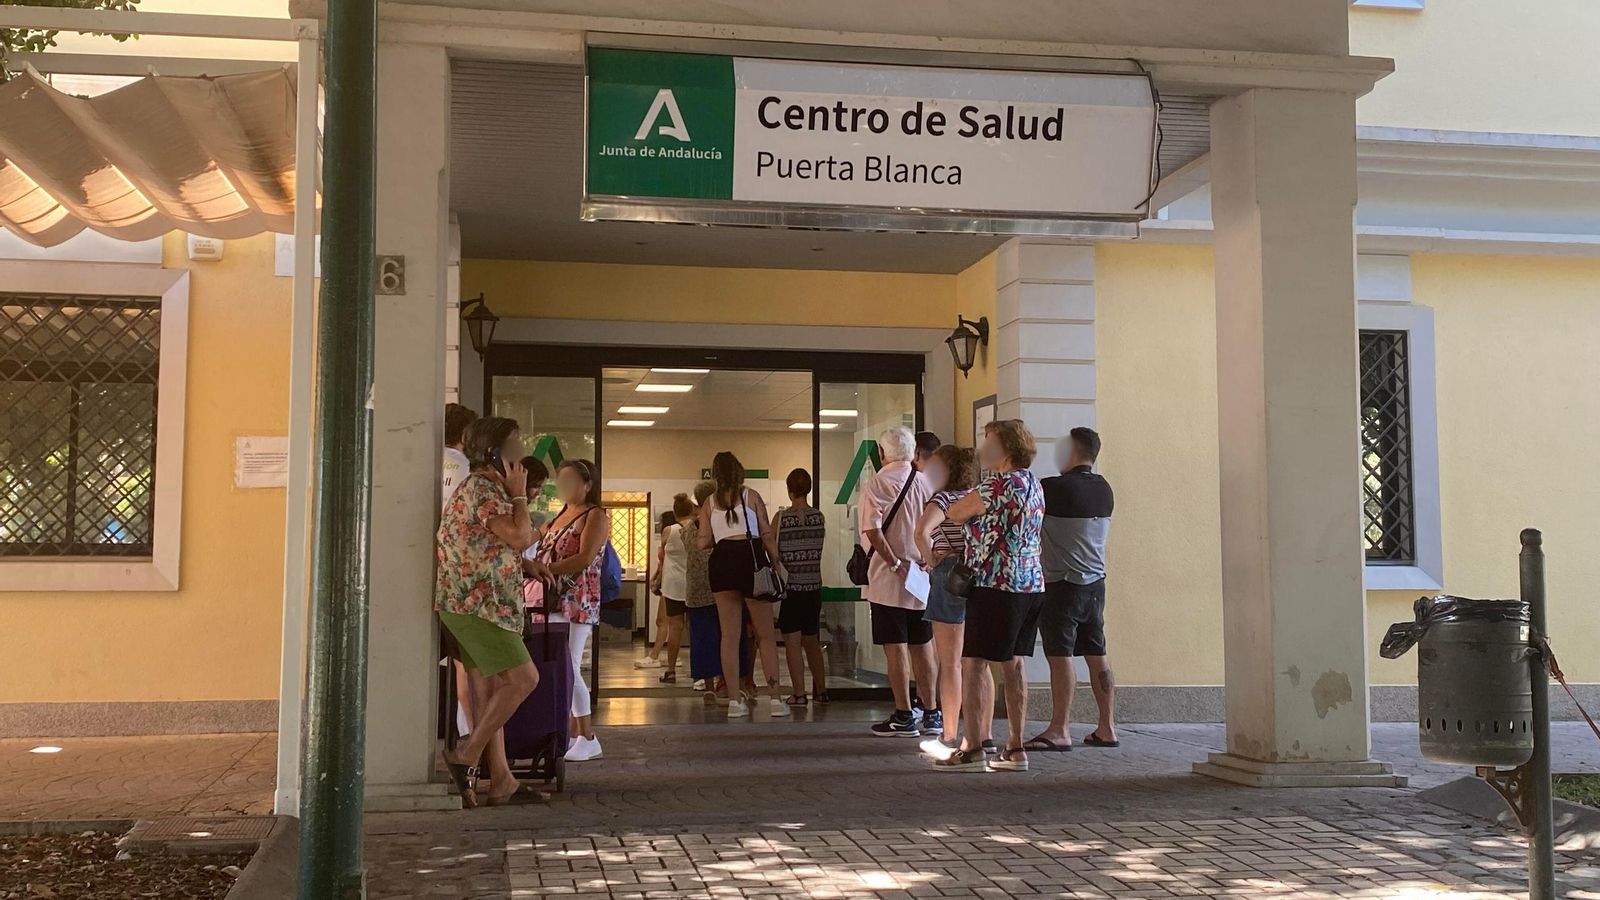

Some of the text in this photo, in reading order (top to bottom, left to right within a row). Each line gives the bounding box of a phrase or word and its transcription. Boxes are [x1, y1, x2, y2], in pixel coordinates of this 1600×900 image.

[757, 96, 1064, 141] Centro de Salud
[599, 145, 722, 160] Junta de Andalucía
[756, 151, 962, 185] Puerta Blanca
[380, 259, 400, 294] 6
